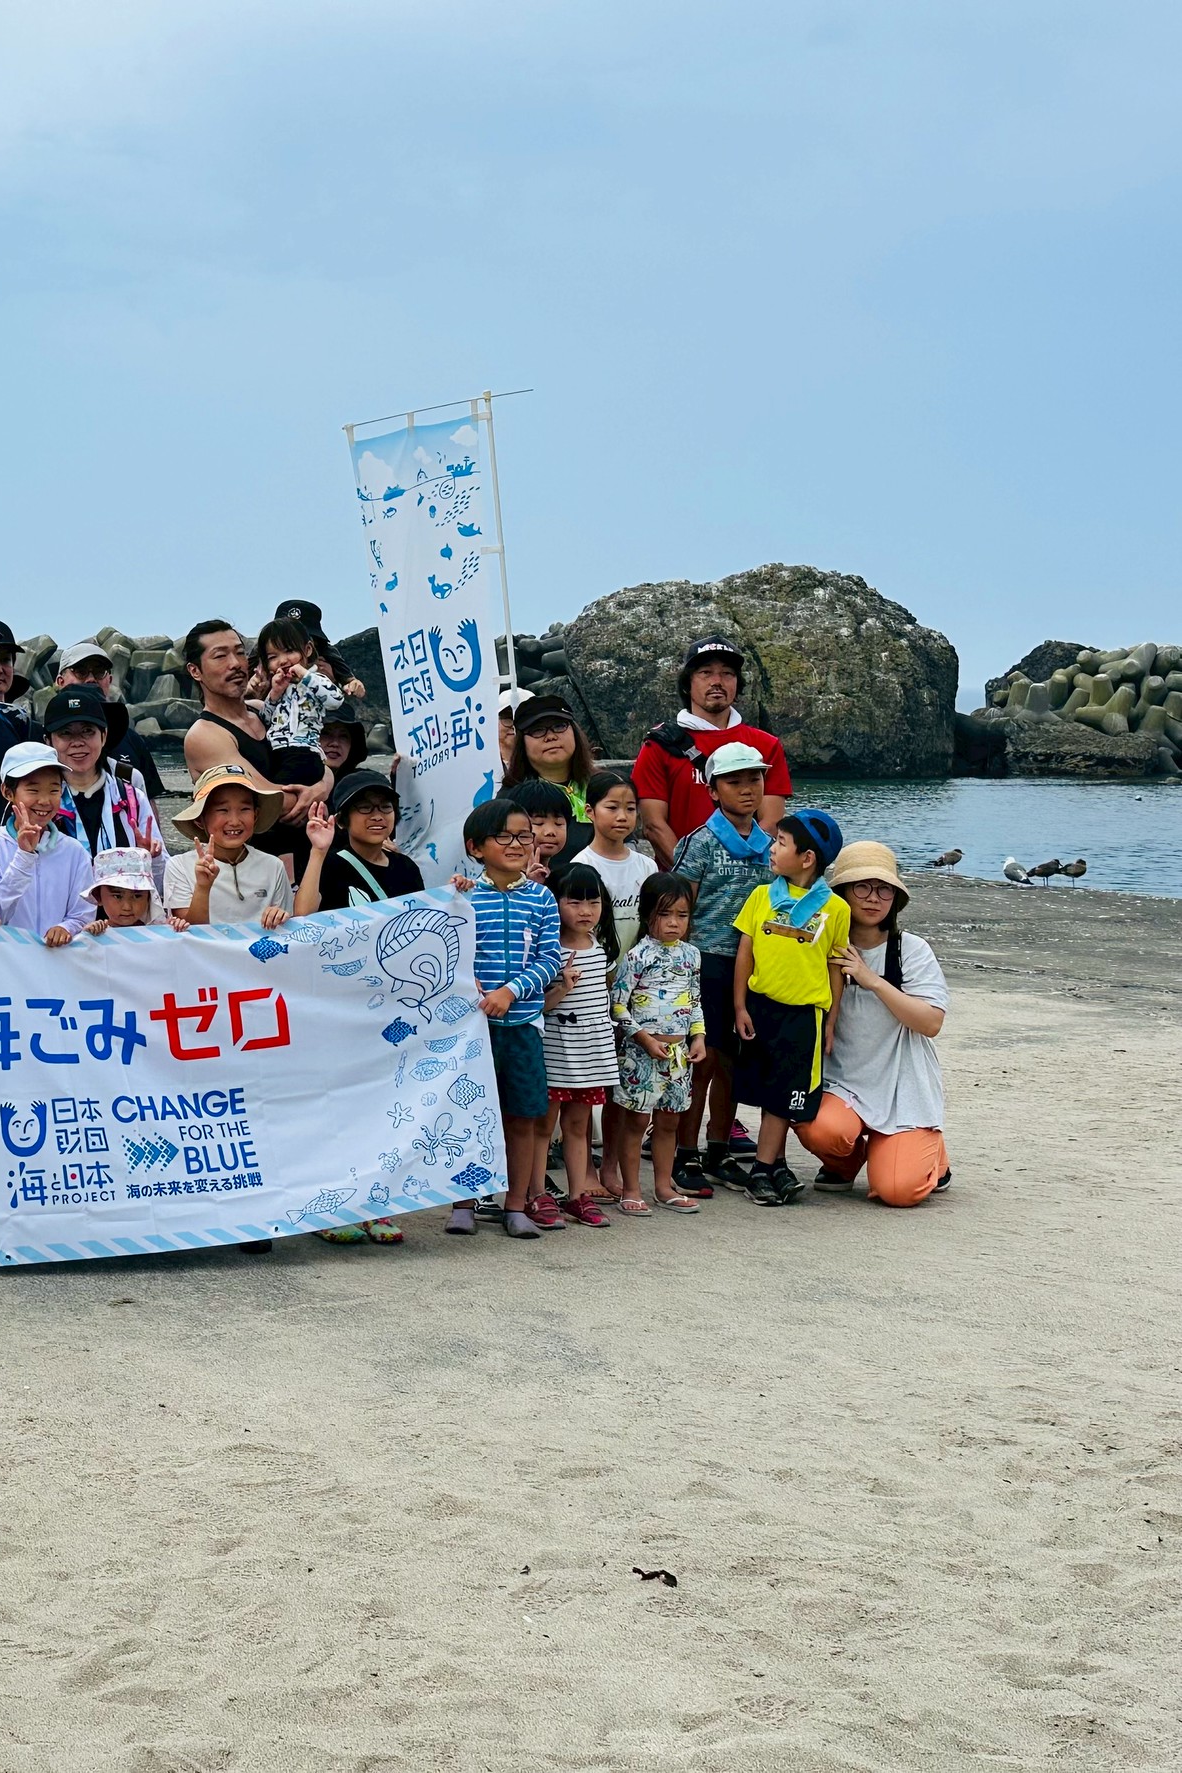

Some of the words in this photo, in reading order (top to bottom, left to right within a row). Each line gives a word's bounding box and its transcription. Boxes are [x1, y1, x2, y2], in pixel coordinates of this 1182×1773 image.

[51, 1097, 103, 1124] 日本
[111, 1087, 247, 1124] CHANGE
[178, 1122, 214, 1142] FOR
[216, 1120, 251, 1138] THE
[182, 1140, 259, 1175] BLUE
[6, 1161, 115, 1209] 海と日本
[51, 1189, 117, 1206] PROJECT
[126, 1171, 264, 1199] 海の未来を変える挑戦
